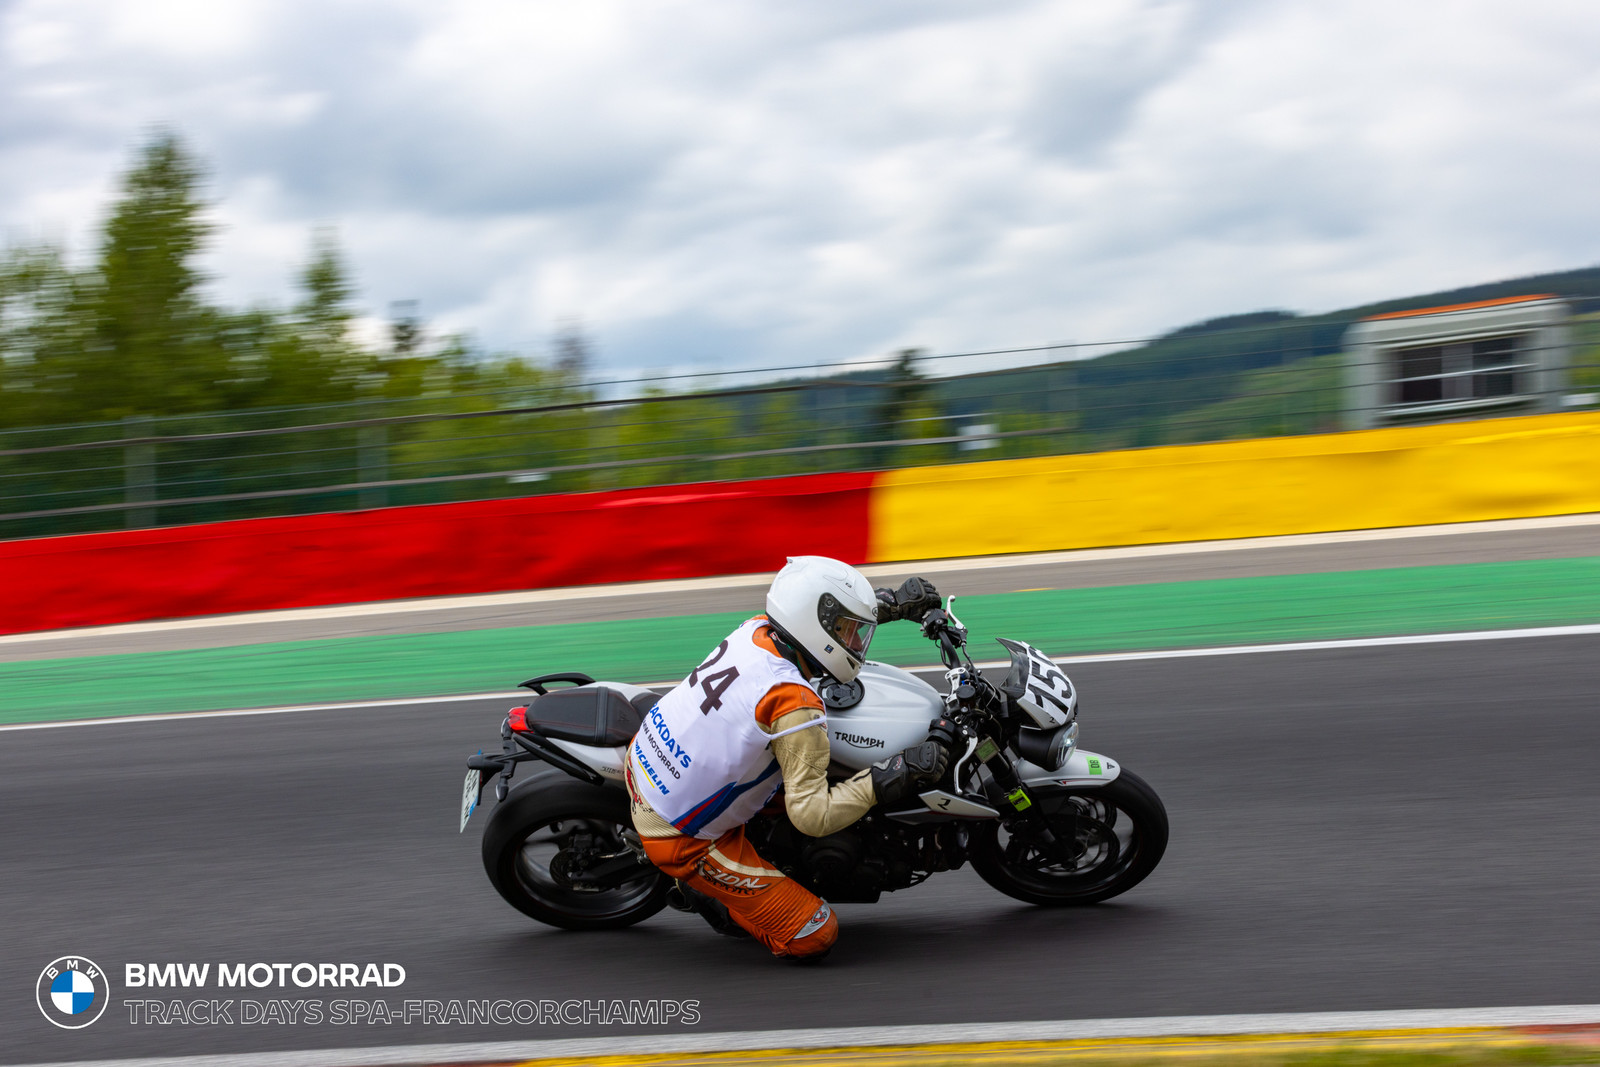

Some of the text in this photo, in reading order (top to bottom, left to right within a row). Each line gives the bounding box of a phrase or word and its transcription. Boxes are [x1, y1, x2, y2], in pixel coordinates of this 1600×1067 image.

[688, 639, 740, 716] 24
[647, 733, 681, 780] MOTORRAD
[835, 731, 885, 748] TRIUMPH
[635, 741, 670, 796] MICHELIN
